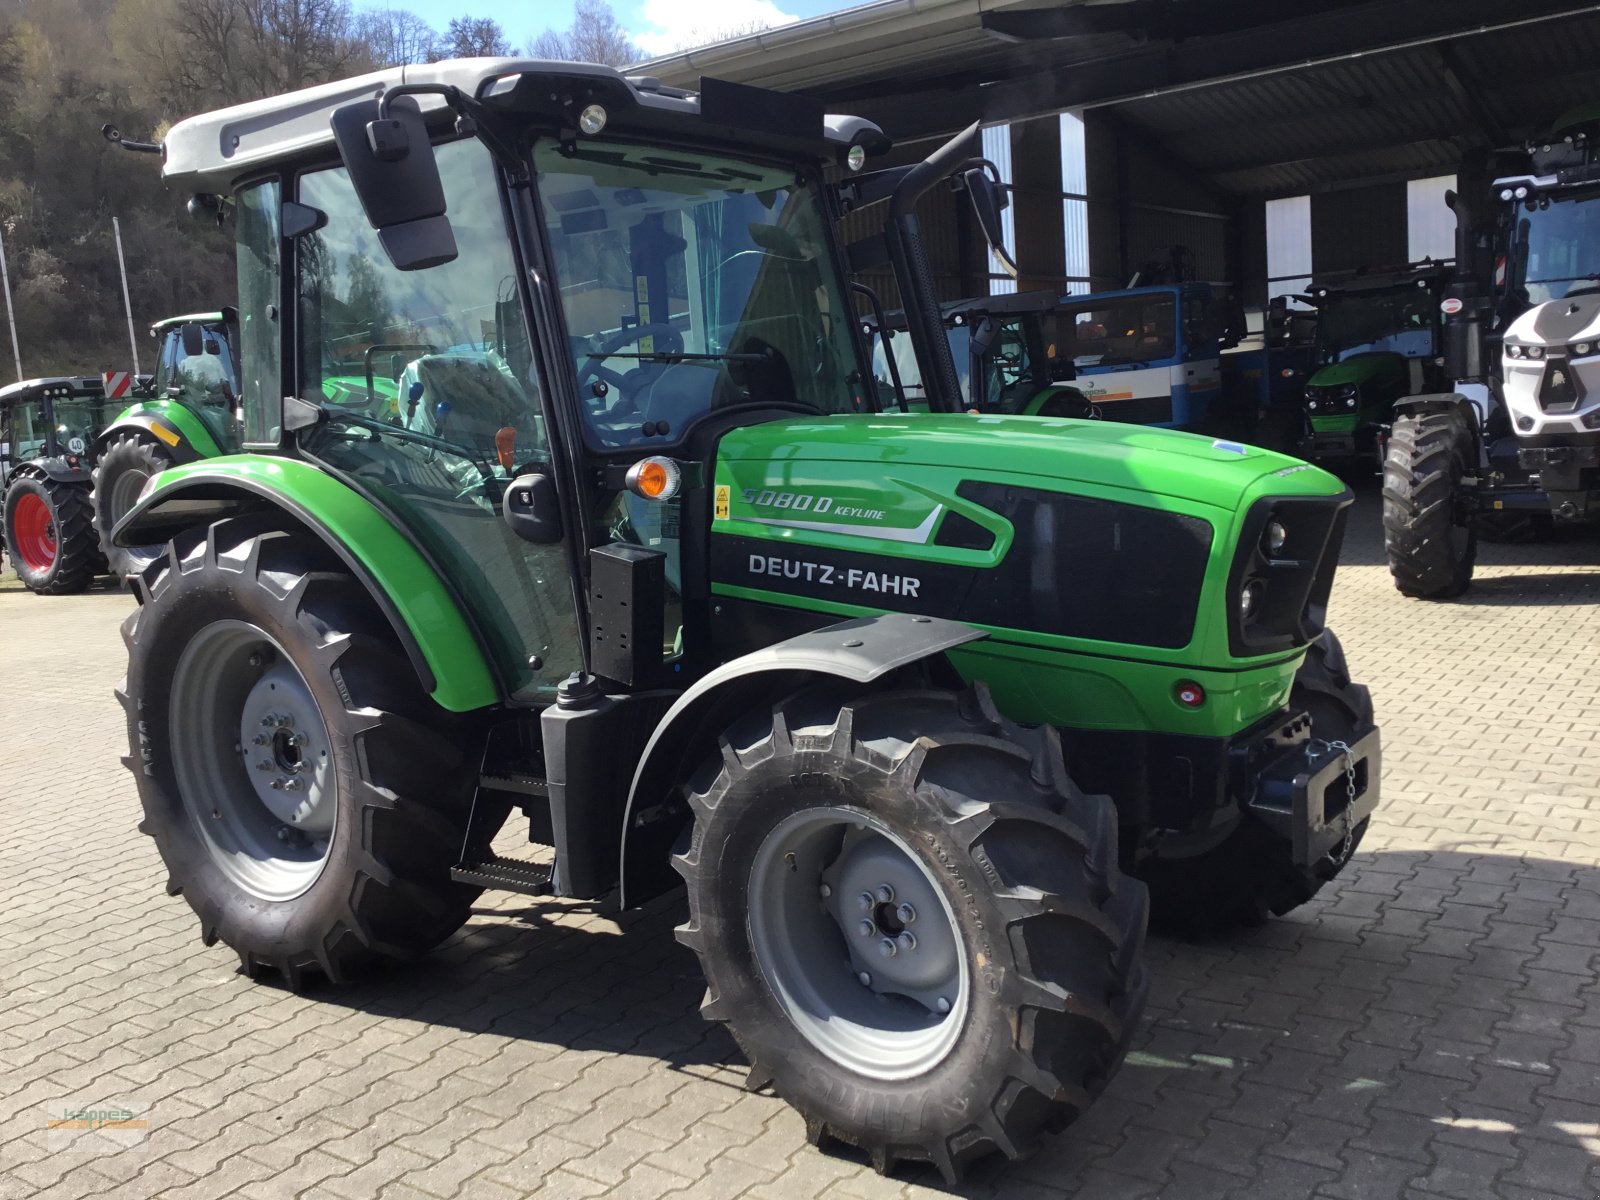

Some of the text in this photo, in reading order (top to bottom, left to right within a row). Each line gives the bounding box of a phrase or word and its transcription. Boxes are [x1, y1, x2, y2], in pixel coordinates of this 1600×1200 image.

[71, 440, 82, 450] 40
[738, 488, 887, 520] 5080 D KEYLINE
[749, 554, 921, 598] DEUTZ-FAHR
